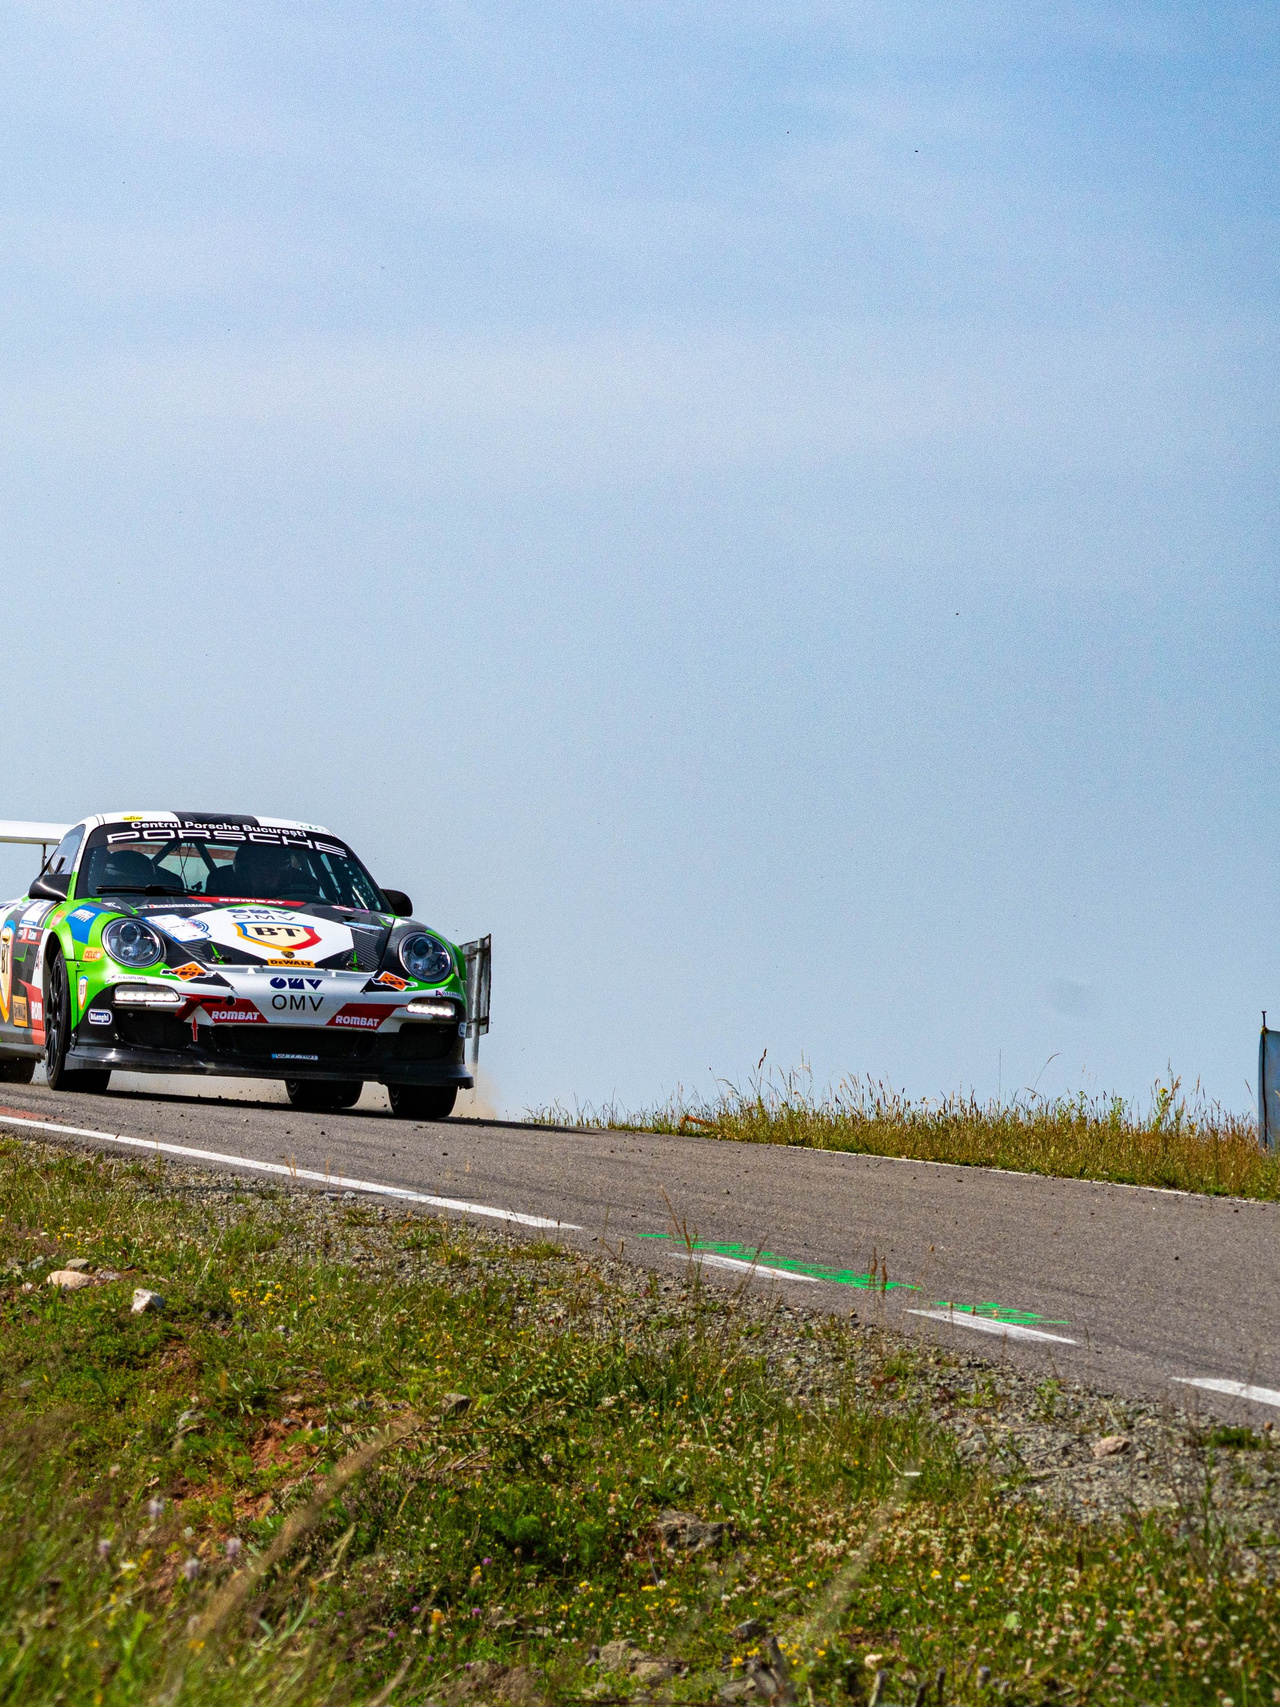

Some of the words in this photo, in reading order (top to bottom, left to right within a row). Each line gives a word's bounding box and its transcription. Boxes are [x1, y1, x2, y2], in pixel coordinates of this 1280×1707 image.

[131, 821, 181, 829] Centrul
[185, 821, 240, 831] Porsche
[107, 829, 347, 858] PORSCHE
[252, 927, 301, 937] BT
[271, 994, 325, 1012] OMV
[211, 1010, 260, 1021] ROMBAT
[335, 1015, 380, 1027] ROMBAT
